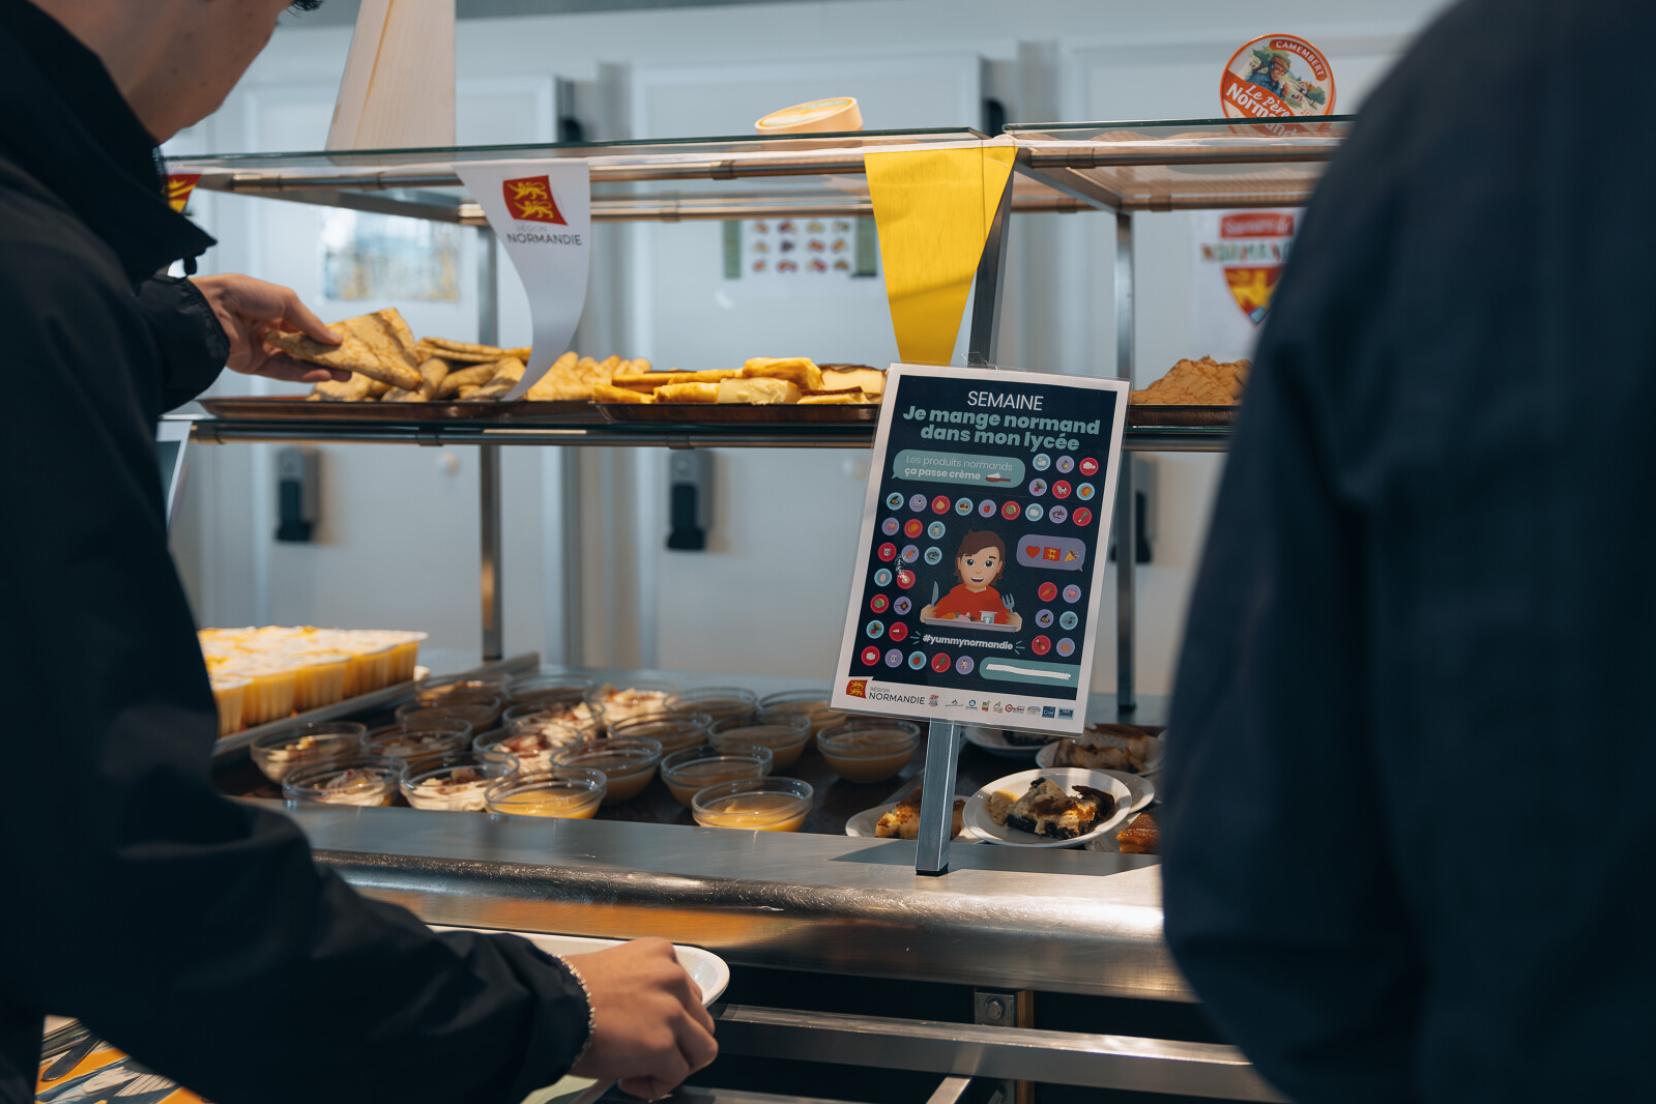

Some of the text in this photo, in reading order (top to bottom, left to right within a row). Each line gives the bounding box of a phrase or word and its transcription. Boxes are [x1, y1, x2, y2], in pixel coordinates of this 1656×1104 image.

[1275, 40, 1325, 78] CAMEMBERT
[1245, 85, 1263, 101] Le
[506, 232, 583, 246] NORMANDIE
[967, 390, 1044, 410] SEMAINE
[903, 406, 1100, 435] Je mange normand
[920, 424, 1080, 453] dans mon lycée
[923, 457, 962, 468] produits
[963, 462, 1013, 472] normands
[904, 467, 981, 480] ça passe crème
[922, 634, 1013, 650] #yummynormandie
[868, 692, 926, 705] NORMANDIE
